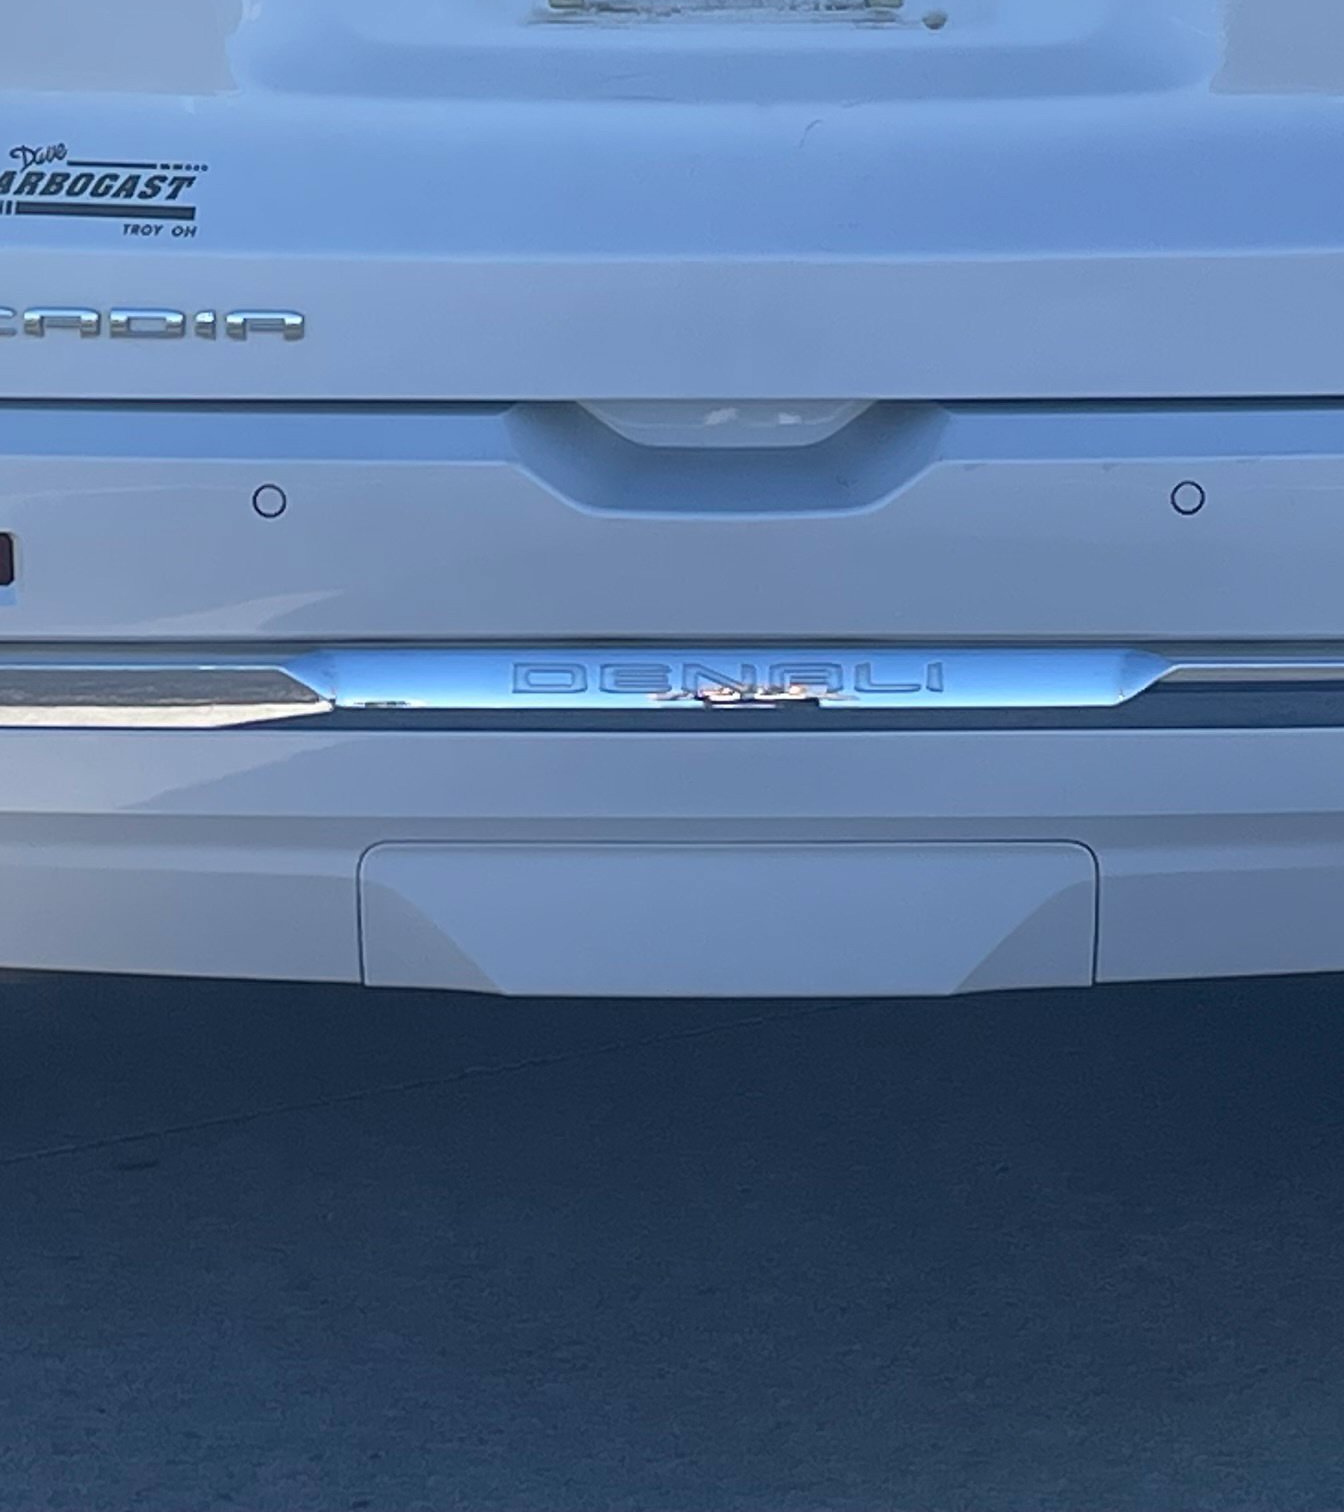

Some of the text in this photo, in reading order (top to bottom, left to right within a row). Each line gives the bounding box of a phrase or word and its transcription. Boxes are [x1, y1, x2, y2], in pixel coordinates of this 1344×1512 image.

[9, 142, 68, 172] Dave
[122, 223, 197, 238] TROY OH
[512, 662, 944, 694] DENALI
